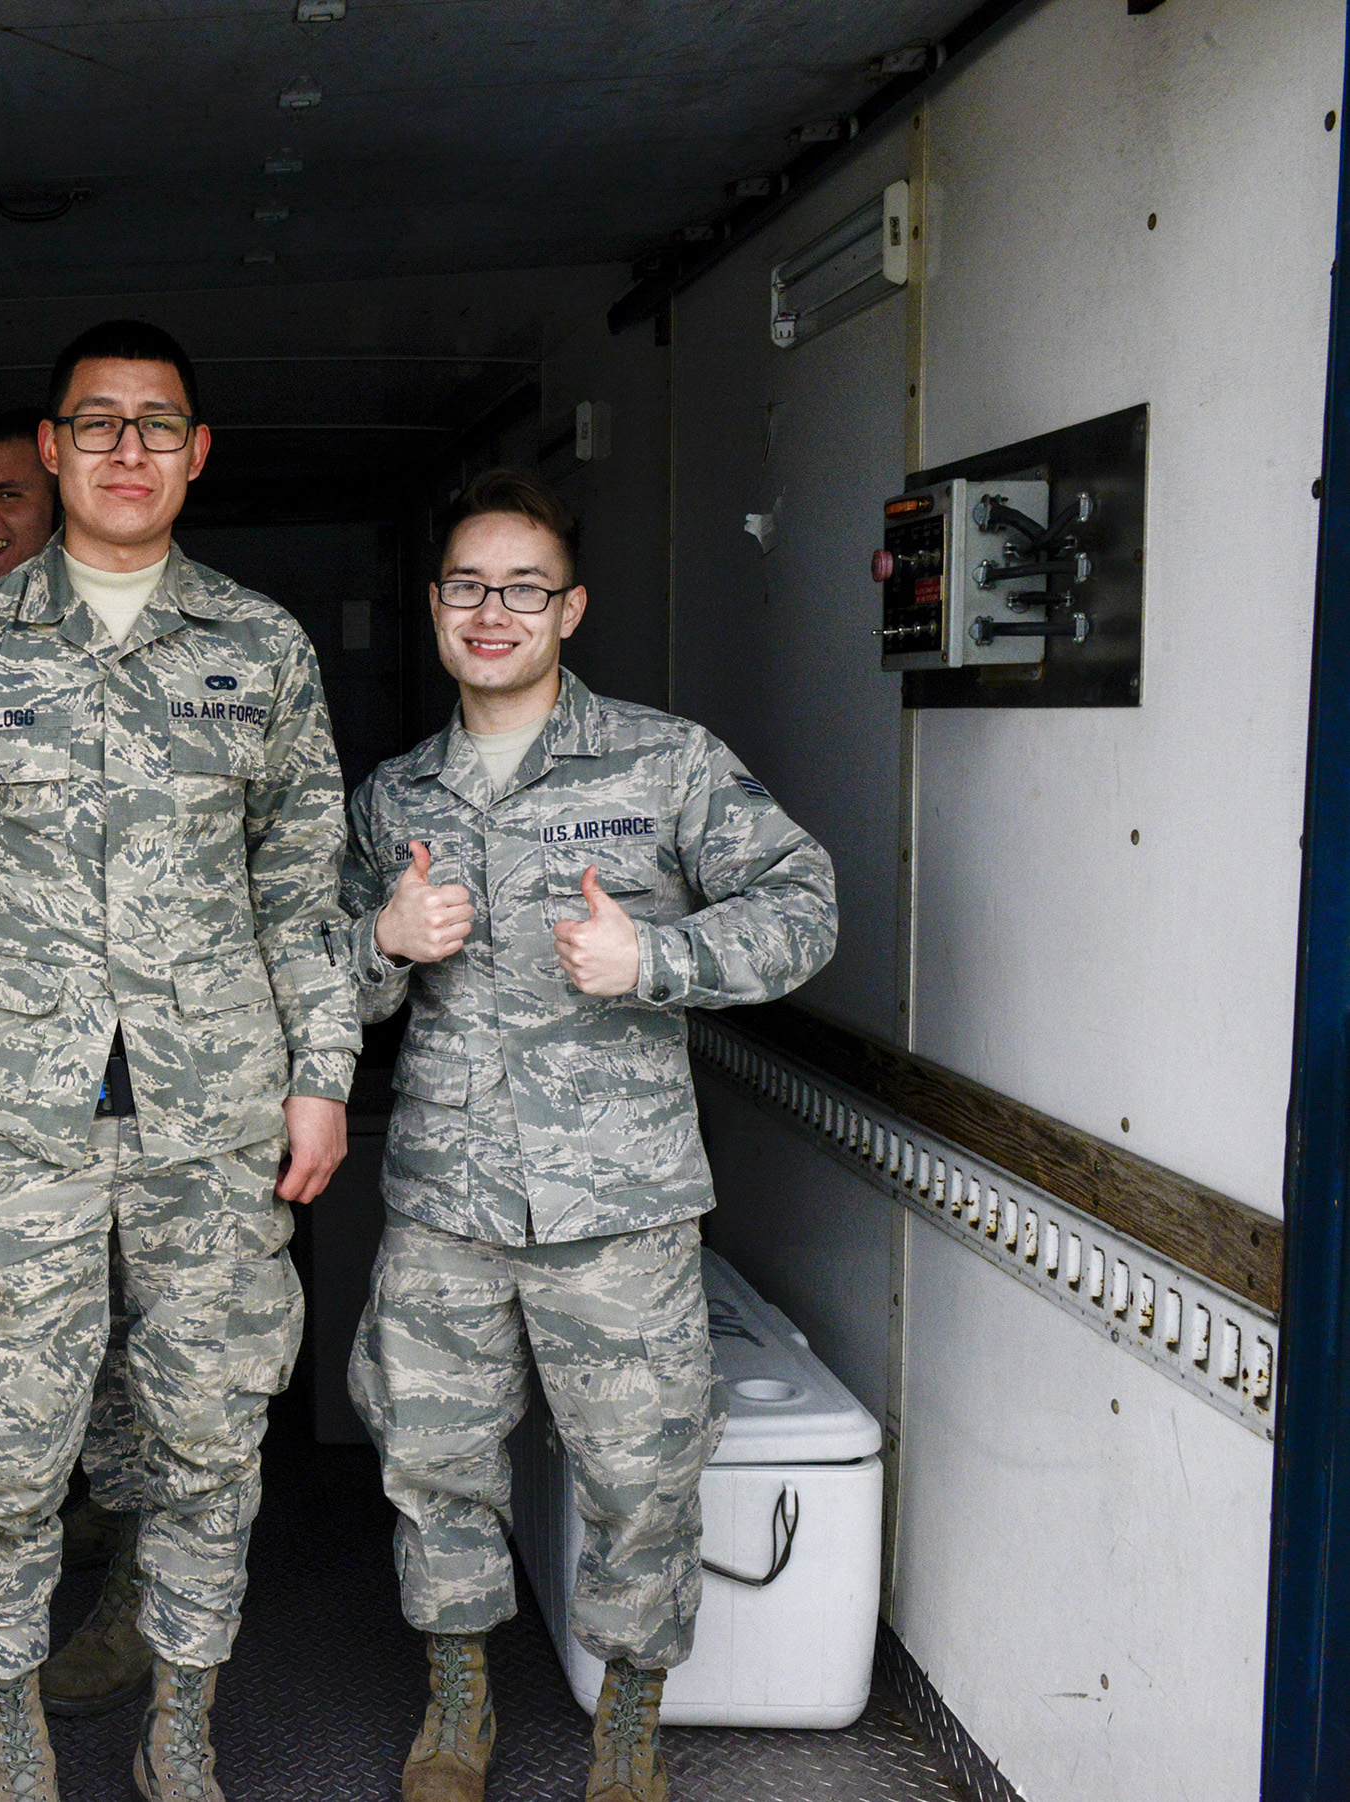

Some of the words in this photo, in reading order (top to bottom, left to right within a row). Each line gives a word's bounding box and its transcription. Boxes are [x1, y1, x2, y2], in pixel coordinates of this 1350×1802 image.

[171, 701, 198, 718] U.S.
[201, 702, 226, 719] AIR
[228, 704, 267, 726] FORCE
[543, 825, 571, 843] U.S.
[574, 822, 600, 840] AIR
[601, 818, 655, 837] FORCE
